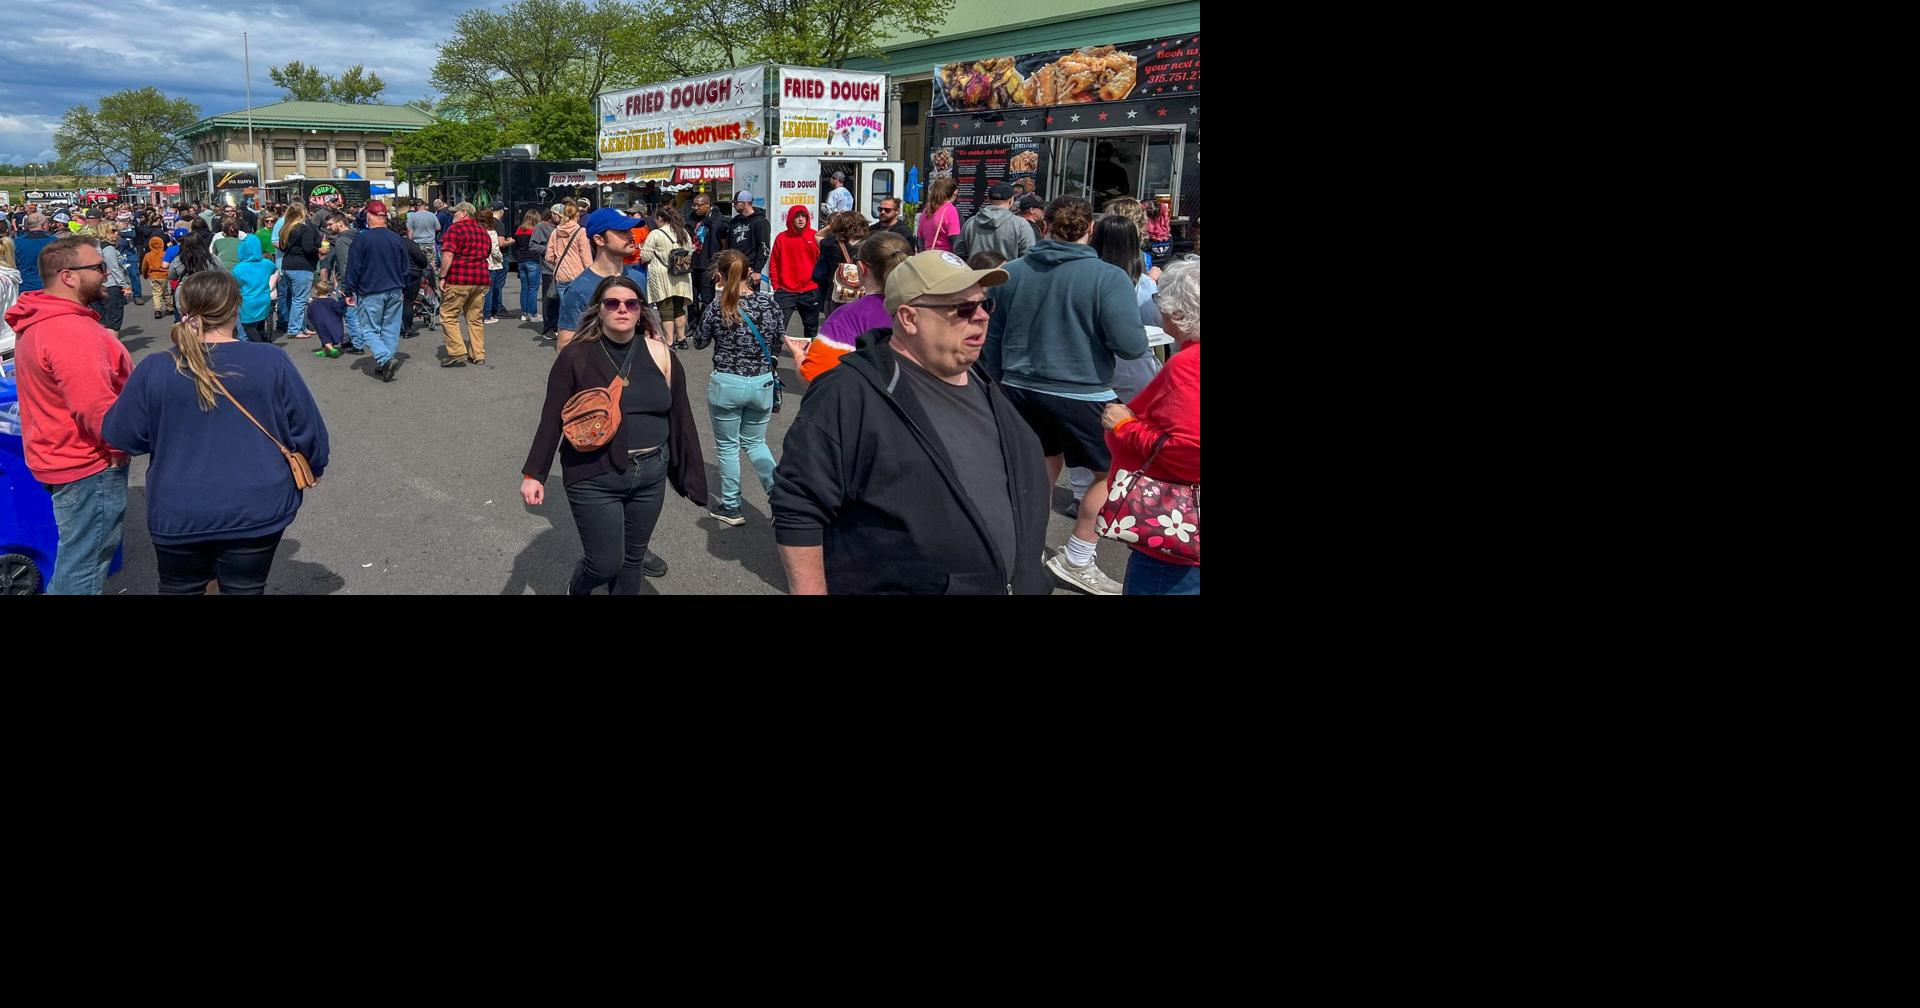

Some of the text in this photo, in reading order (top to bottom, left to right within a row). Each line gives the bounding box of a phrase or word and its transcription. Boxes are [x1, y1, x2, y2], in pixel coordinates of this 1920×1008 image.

[1156, 48, 1183, 59] Book
[1144, 64, 1169, 74] your
[1171, 60, 1192, 70] next
[784, 77, 880, 102] FRIED DOUGH
[626, 78, 732, 116] FRIED DOUGH
[783, 121, 828, 138] LEMONADE
[836, 116, 882, 132] SNO KONES
[600, 132, 666, 153] LEMONADE
[942, 134, 1032, 146] ARTISAN ITALIAN CUISINE
[551, 174, 566, 183] FRIED
[567, 174, 586, 182] DOUGH
[680, 167, 730, 179] FRIED DOUGH
[781, 196, 816, 204] LEMONADE
